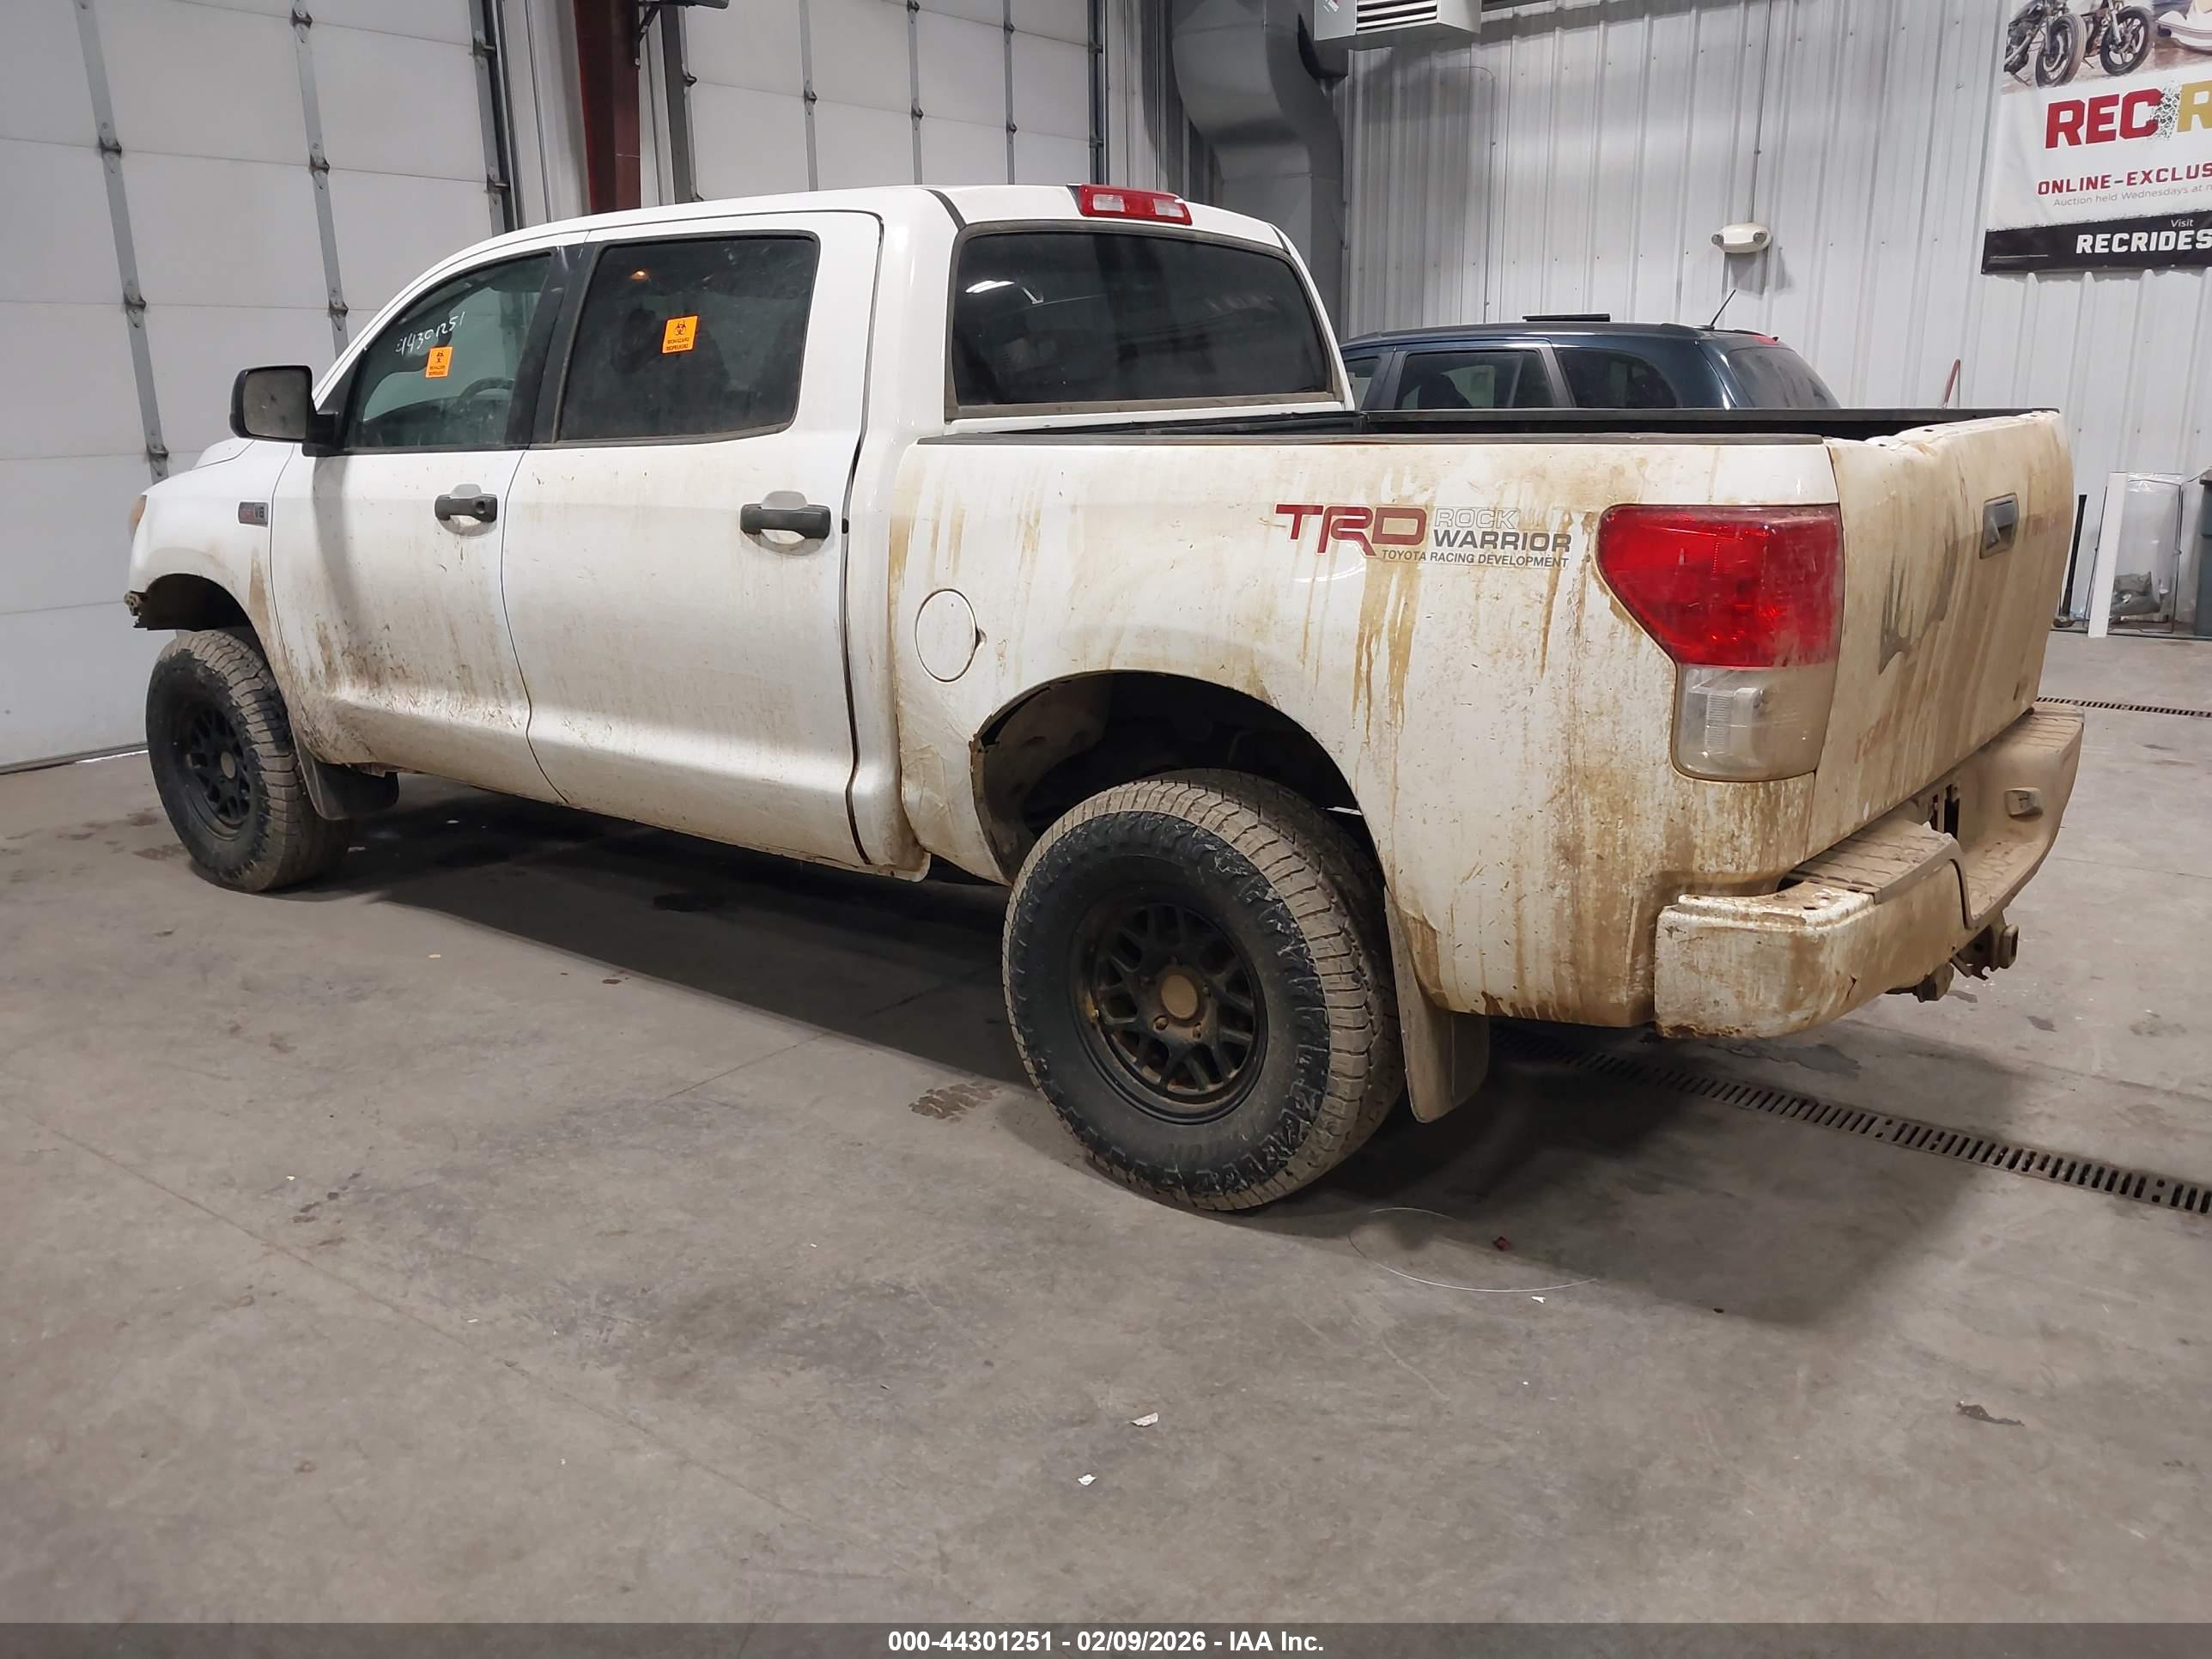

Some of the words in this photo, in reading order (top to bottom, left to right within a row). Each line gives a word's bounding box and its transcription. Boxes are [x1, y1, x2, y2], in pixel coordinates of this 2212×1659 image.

[2045, 88, 2164, 149] REC
[2037, 162, 2212, 196] ONLINE-EXCLUS
[2053, 196, 2093, 207] Auction
[2095, 193, 2118, 204] held
[2121, 185, 2190, 201] Wednesdays
[2191, 185, 2203, 193] at
[2170, 219, 2195, 228] Visit
[2075, 228, 2212, 254] RECRIDES
[1274, 503, 1427, 557] TRD
[1434, 507, 1519, 530] ROCK
[1433, 529, 1572, 552] WARRIOR
[1381, 549, 1426, 562] TOYOTA
[1430, 553, 1474, 564] RACING
[1478, 554, 1569, 568] DEVELOPMENT
